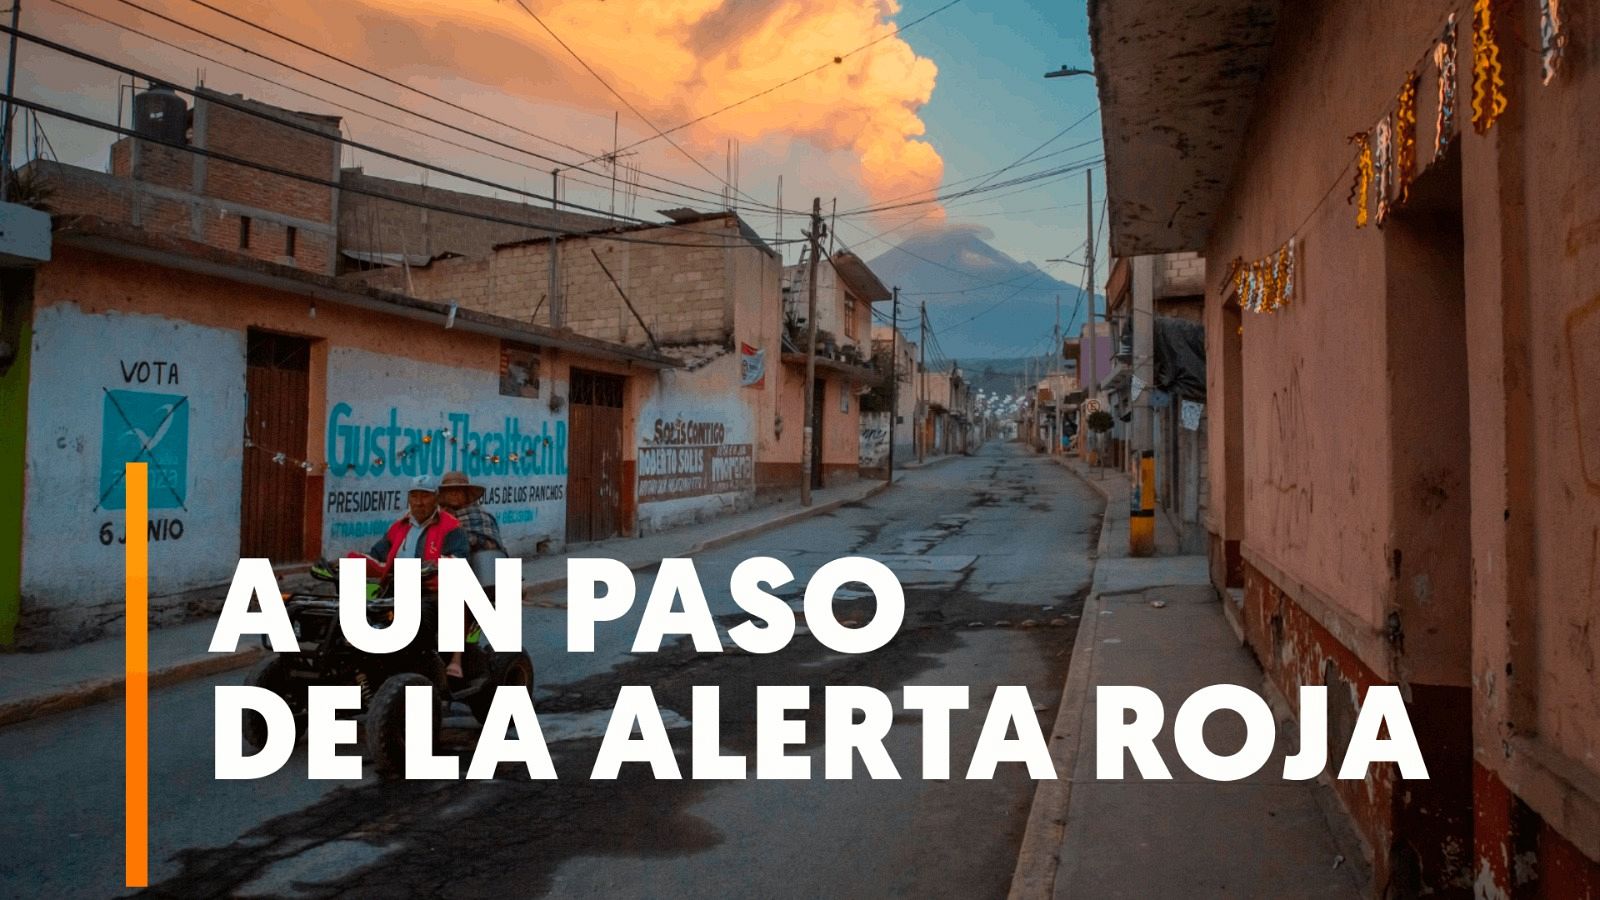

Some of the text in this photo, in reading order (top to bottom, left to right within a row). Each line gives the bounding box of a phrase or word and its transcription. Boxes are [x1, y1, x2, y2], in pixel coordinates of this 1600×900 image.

[120, 360, 179, 385] VOTA
[328, 402, 445, 477] Gustavo
[449, 413, 554, 476] Tlacaltech
[688, 420, 725, 445] CONTIGO
[679, 448, 704, 474] SOLIS
[327, 490, 402, 513] PRESIDENTE
[502, 486, 512, 504] DE
[514, 486, 528, 503] LOS
[529, 484, 564, 503] RANCHOS
[99, 521, 114, 545] 6
